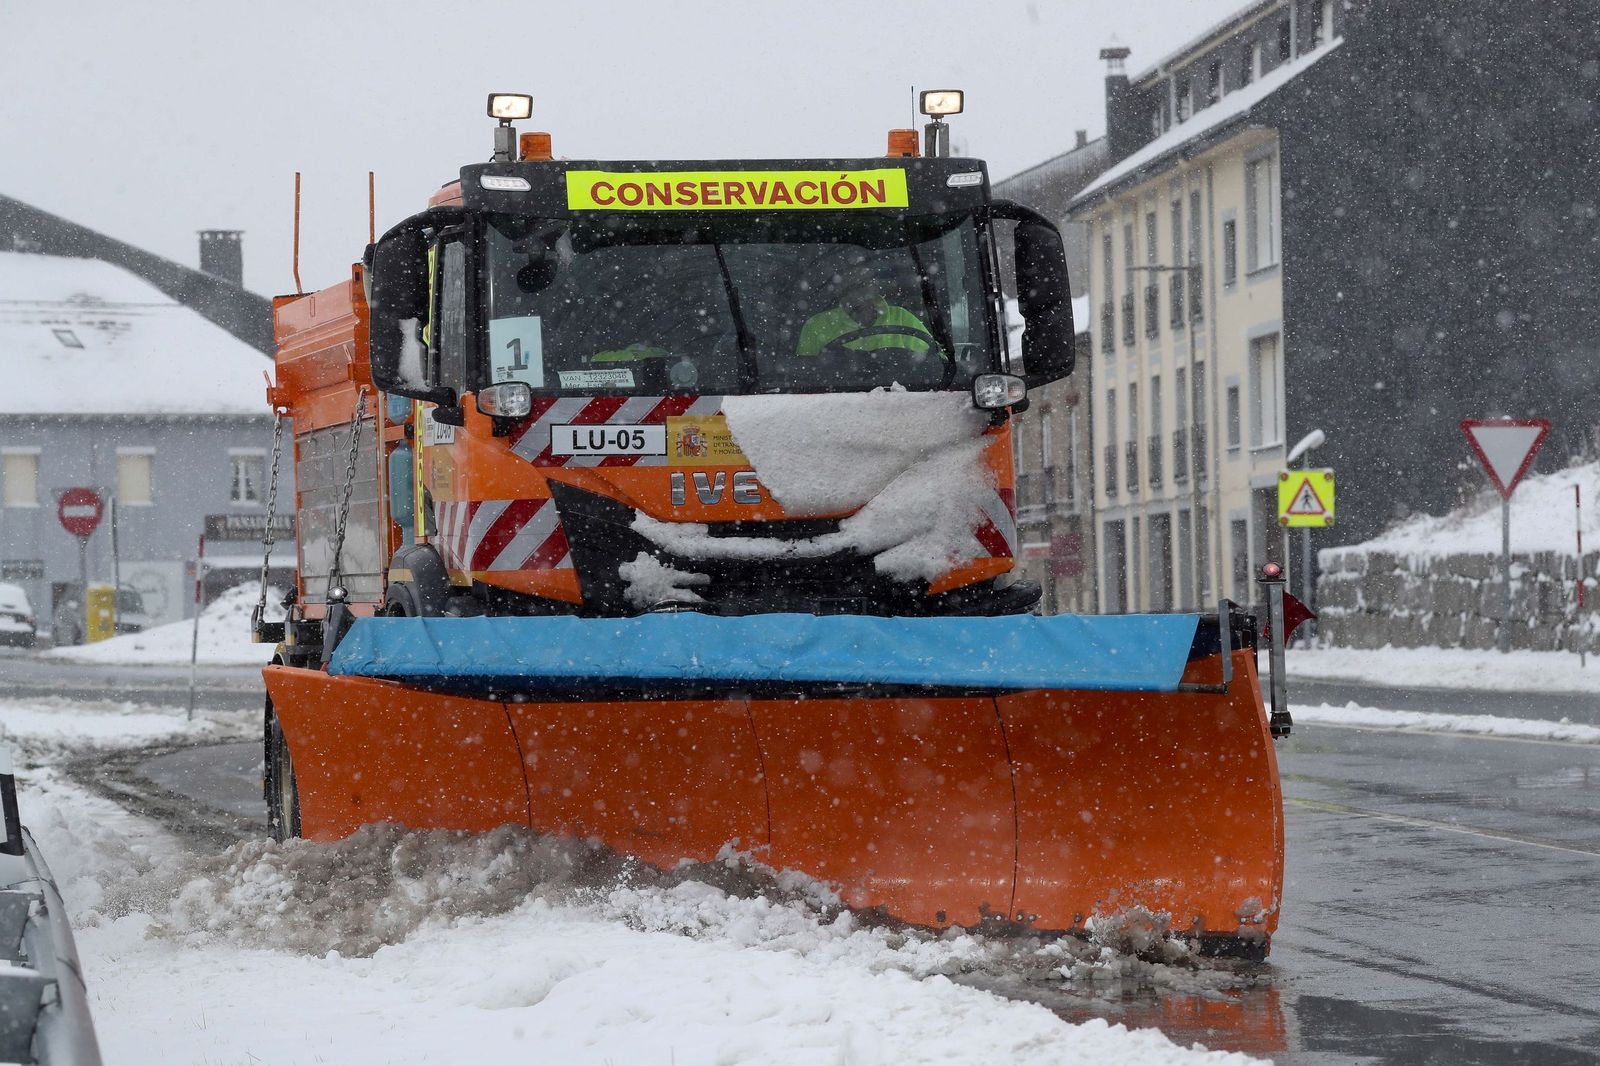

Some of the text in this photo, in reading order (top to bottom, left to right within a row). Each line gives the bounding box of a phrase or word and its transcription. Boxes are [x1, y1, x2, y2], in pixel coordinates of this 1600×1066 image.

[590, 173, 886, 206] CONSERVACIÓN
[506, 338, 528, 371] 1
[572, 429, 646, 450] LU-05
[671, 471, 762, 505] IVE
